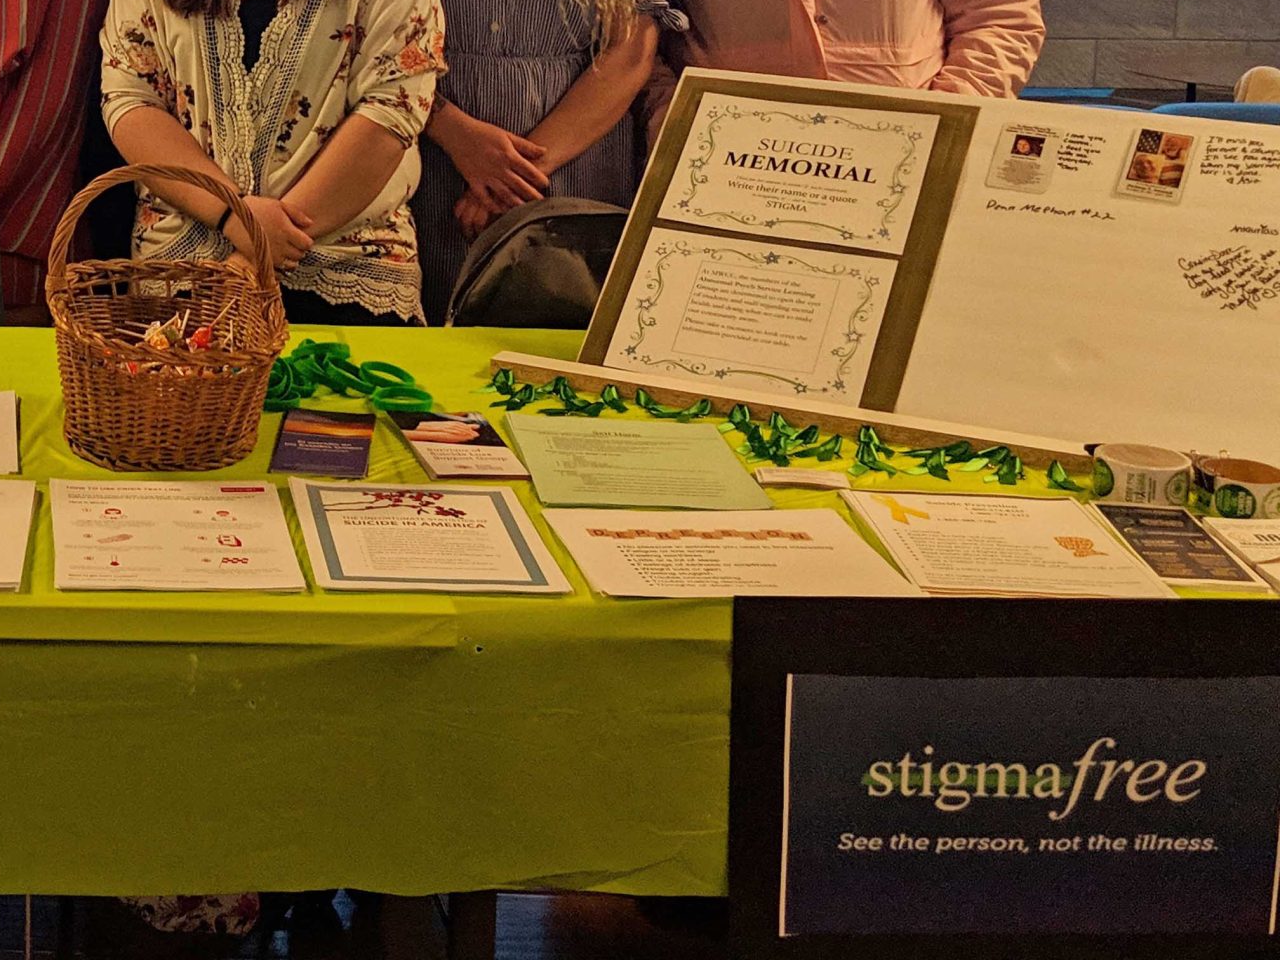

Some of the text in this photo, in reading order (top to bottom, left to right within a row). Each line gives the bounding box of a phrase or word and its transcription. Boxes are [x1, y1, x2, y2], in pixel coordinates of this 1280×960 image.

[757, 137, 854, 161] SUICIDE
[723, 151, 877, 184] MEMORIAL
[728, 180, 754, 191] Write
[755, 182, 779, 194] their
[780, 187, 807, 199] name
[809, 192, 820, 200] or
[829, 194, 858, 204] quote
[765, 200, 807, 213] STIGMA
[344, 519, 398, 527] SUICIDE
[421, 521, 486, 530] AMERICA
[588, 528, 812, 541] DEPRESSION
[866, 736, 1208, 821] stigmafree
[837, 832, 1220, 855] See the person, not the illness.
